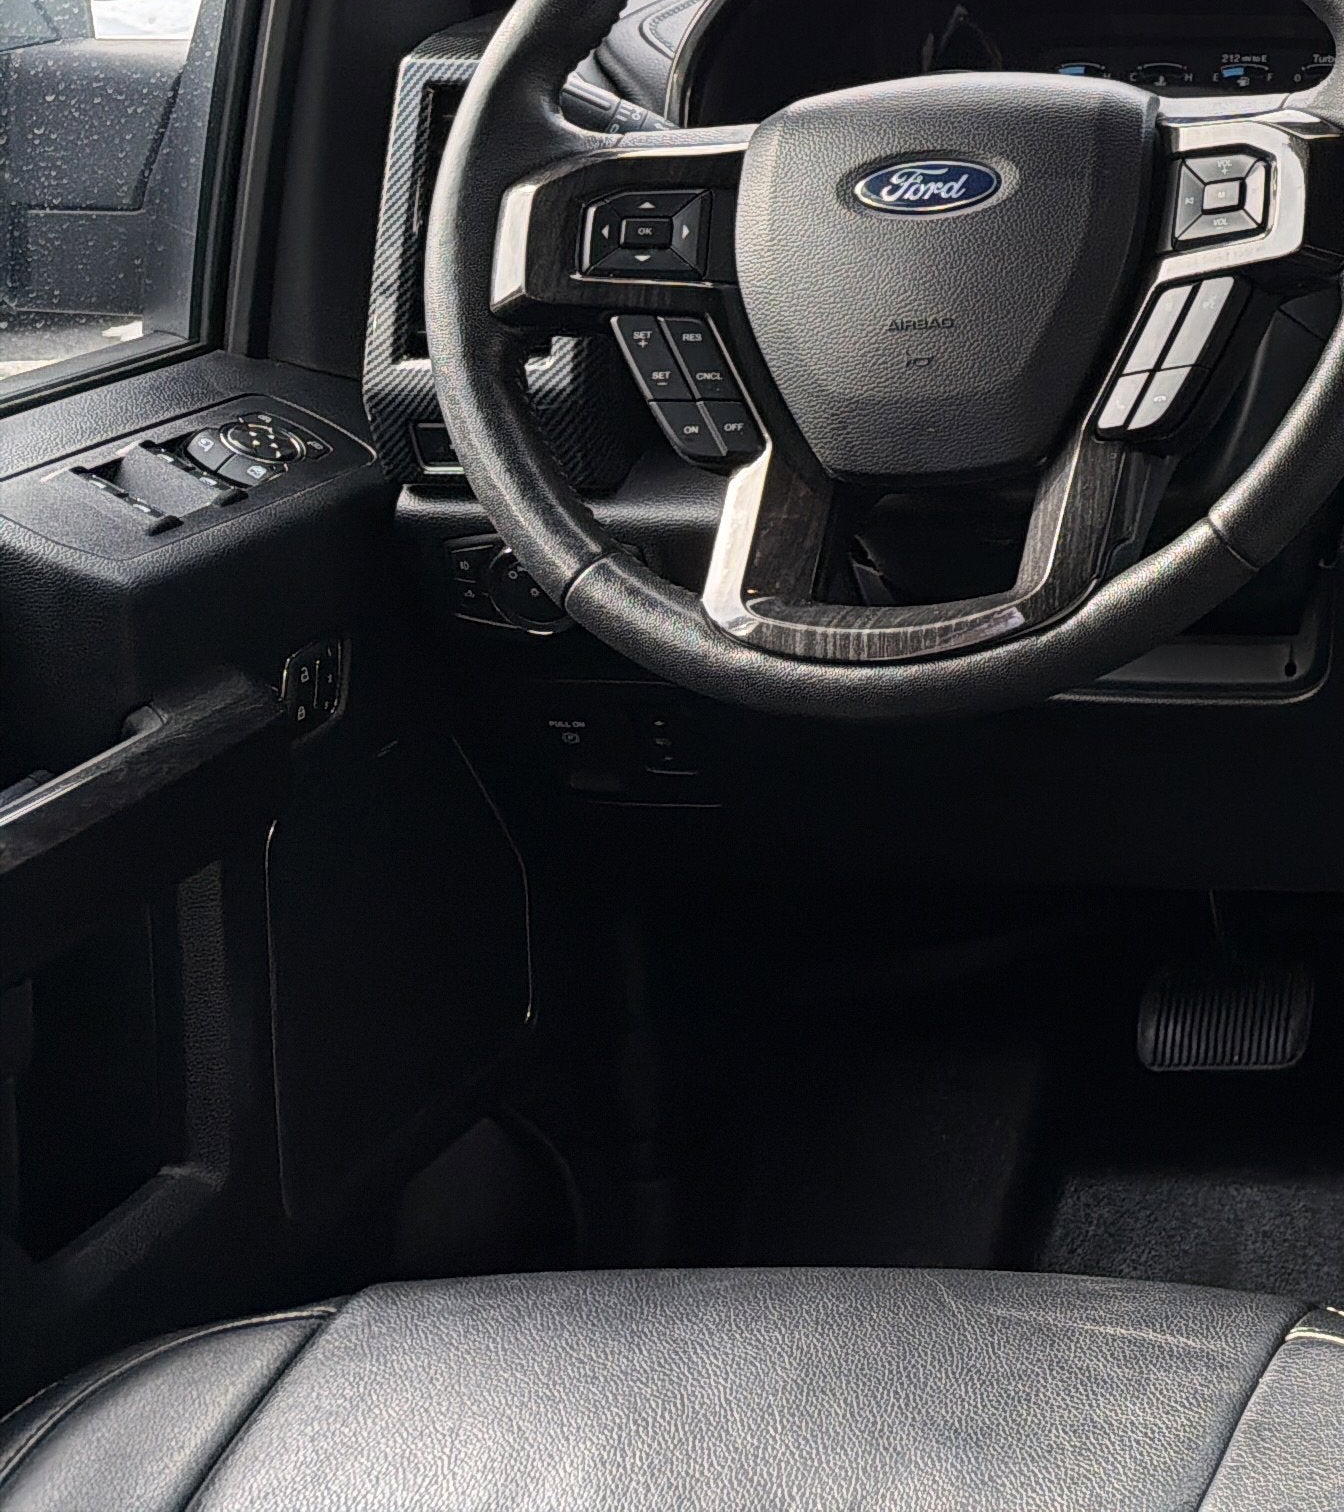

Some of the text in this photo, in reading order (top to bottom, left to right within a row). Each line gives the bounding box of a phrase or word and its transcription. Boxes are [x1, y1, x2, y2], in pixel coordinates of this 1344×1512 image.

[1222, 54, 1240, 63] 212
[1313, 54, 1337, 64] Turb
[881, 168, 969, 202] Ford
[638, 227, 652, 236] OK
[888, 316, 954, 332] AIRBAG
[633, 331, 653, 340] SET
[682, 332, 703, 342] RES
[651, 371, 671, 380] SET
[695, 371, 723, 381] CNCL
[683, 424, 699, 435] ON
[704, 422, 724, 433] OFF
